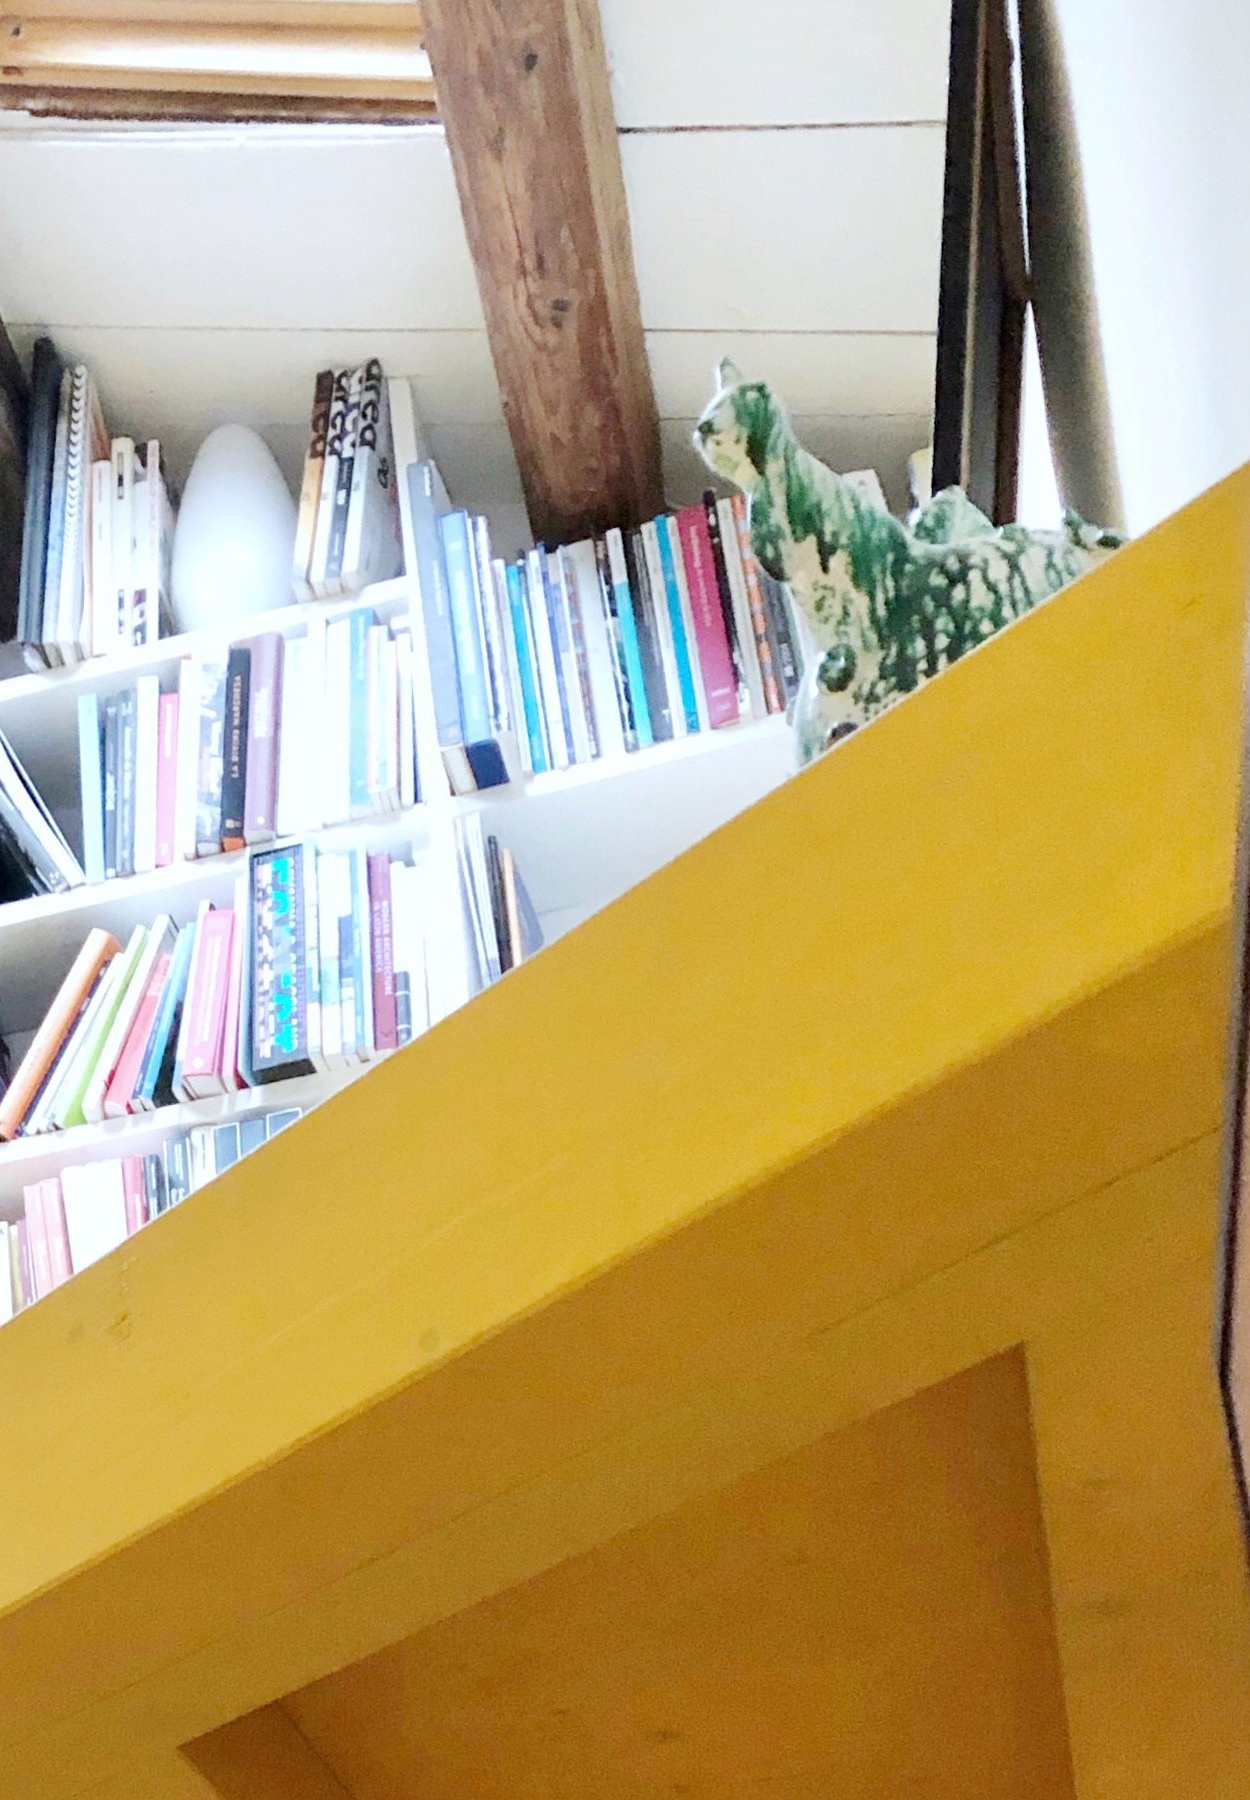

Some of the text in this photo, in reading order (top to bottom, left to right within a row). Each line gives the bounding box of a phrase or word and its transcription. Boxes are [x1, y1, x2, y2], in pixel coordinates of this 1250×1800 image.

[359, 357, 384, 451] area
[374, 938, 383, 973] AMERICA
[382, 900, 393, 996] MODERN ARCHITECTURE
